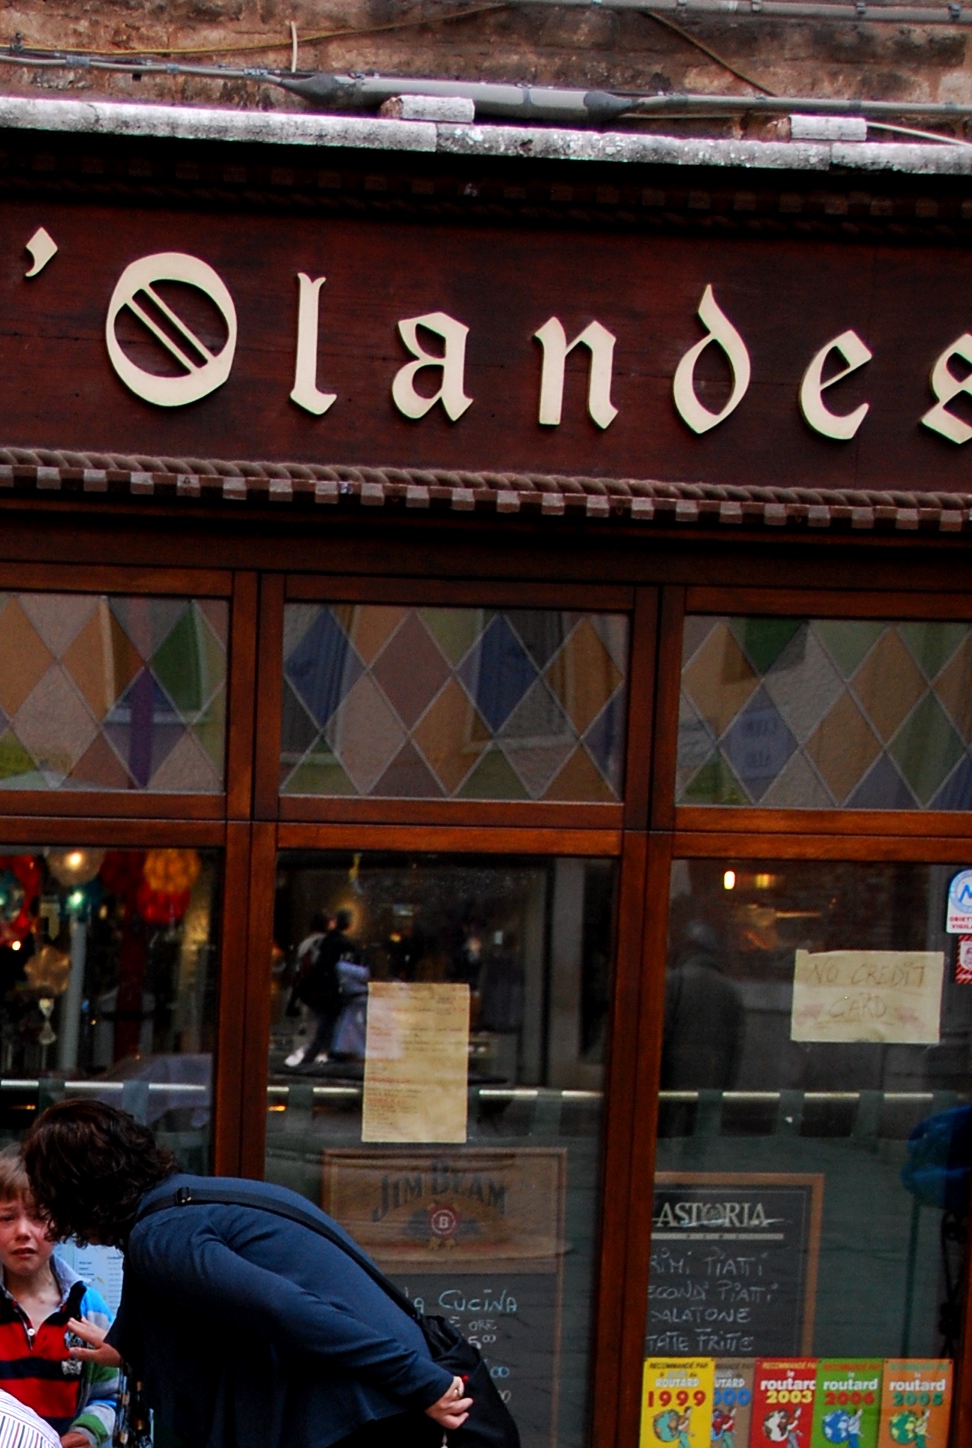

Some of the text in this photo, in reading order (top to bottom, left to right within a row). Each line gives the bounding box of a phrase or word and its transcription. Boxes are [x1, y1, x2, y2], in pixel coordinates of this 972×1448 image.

[806, 958, 926, 987] NO CREDIT
[371, 1159, 506, 1222] JIM BEAM
[657, 1201, 769, 1228] ASTORIA
[439, 1288, 517, 1312] CUCINA
[645, 1330, 689, 1352] TATE
[823, 1378, 878, 1391] routard
[889, 1377, 946, 1392] routard
[647, 1389, 707, 1409] 1999
[765, 1390, 813, 1404] 2003
